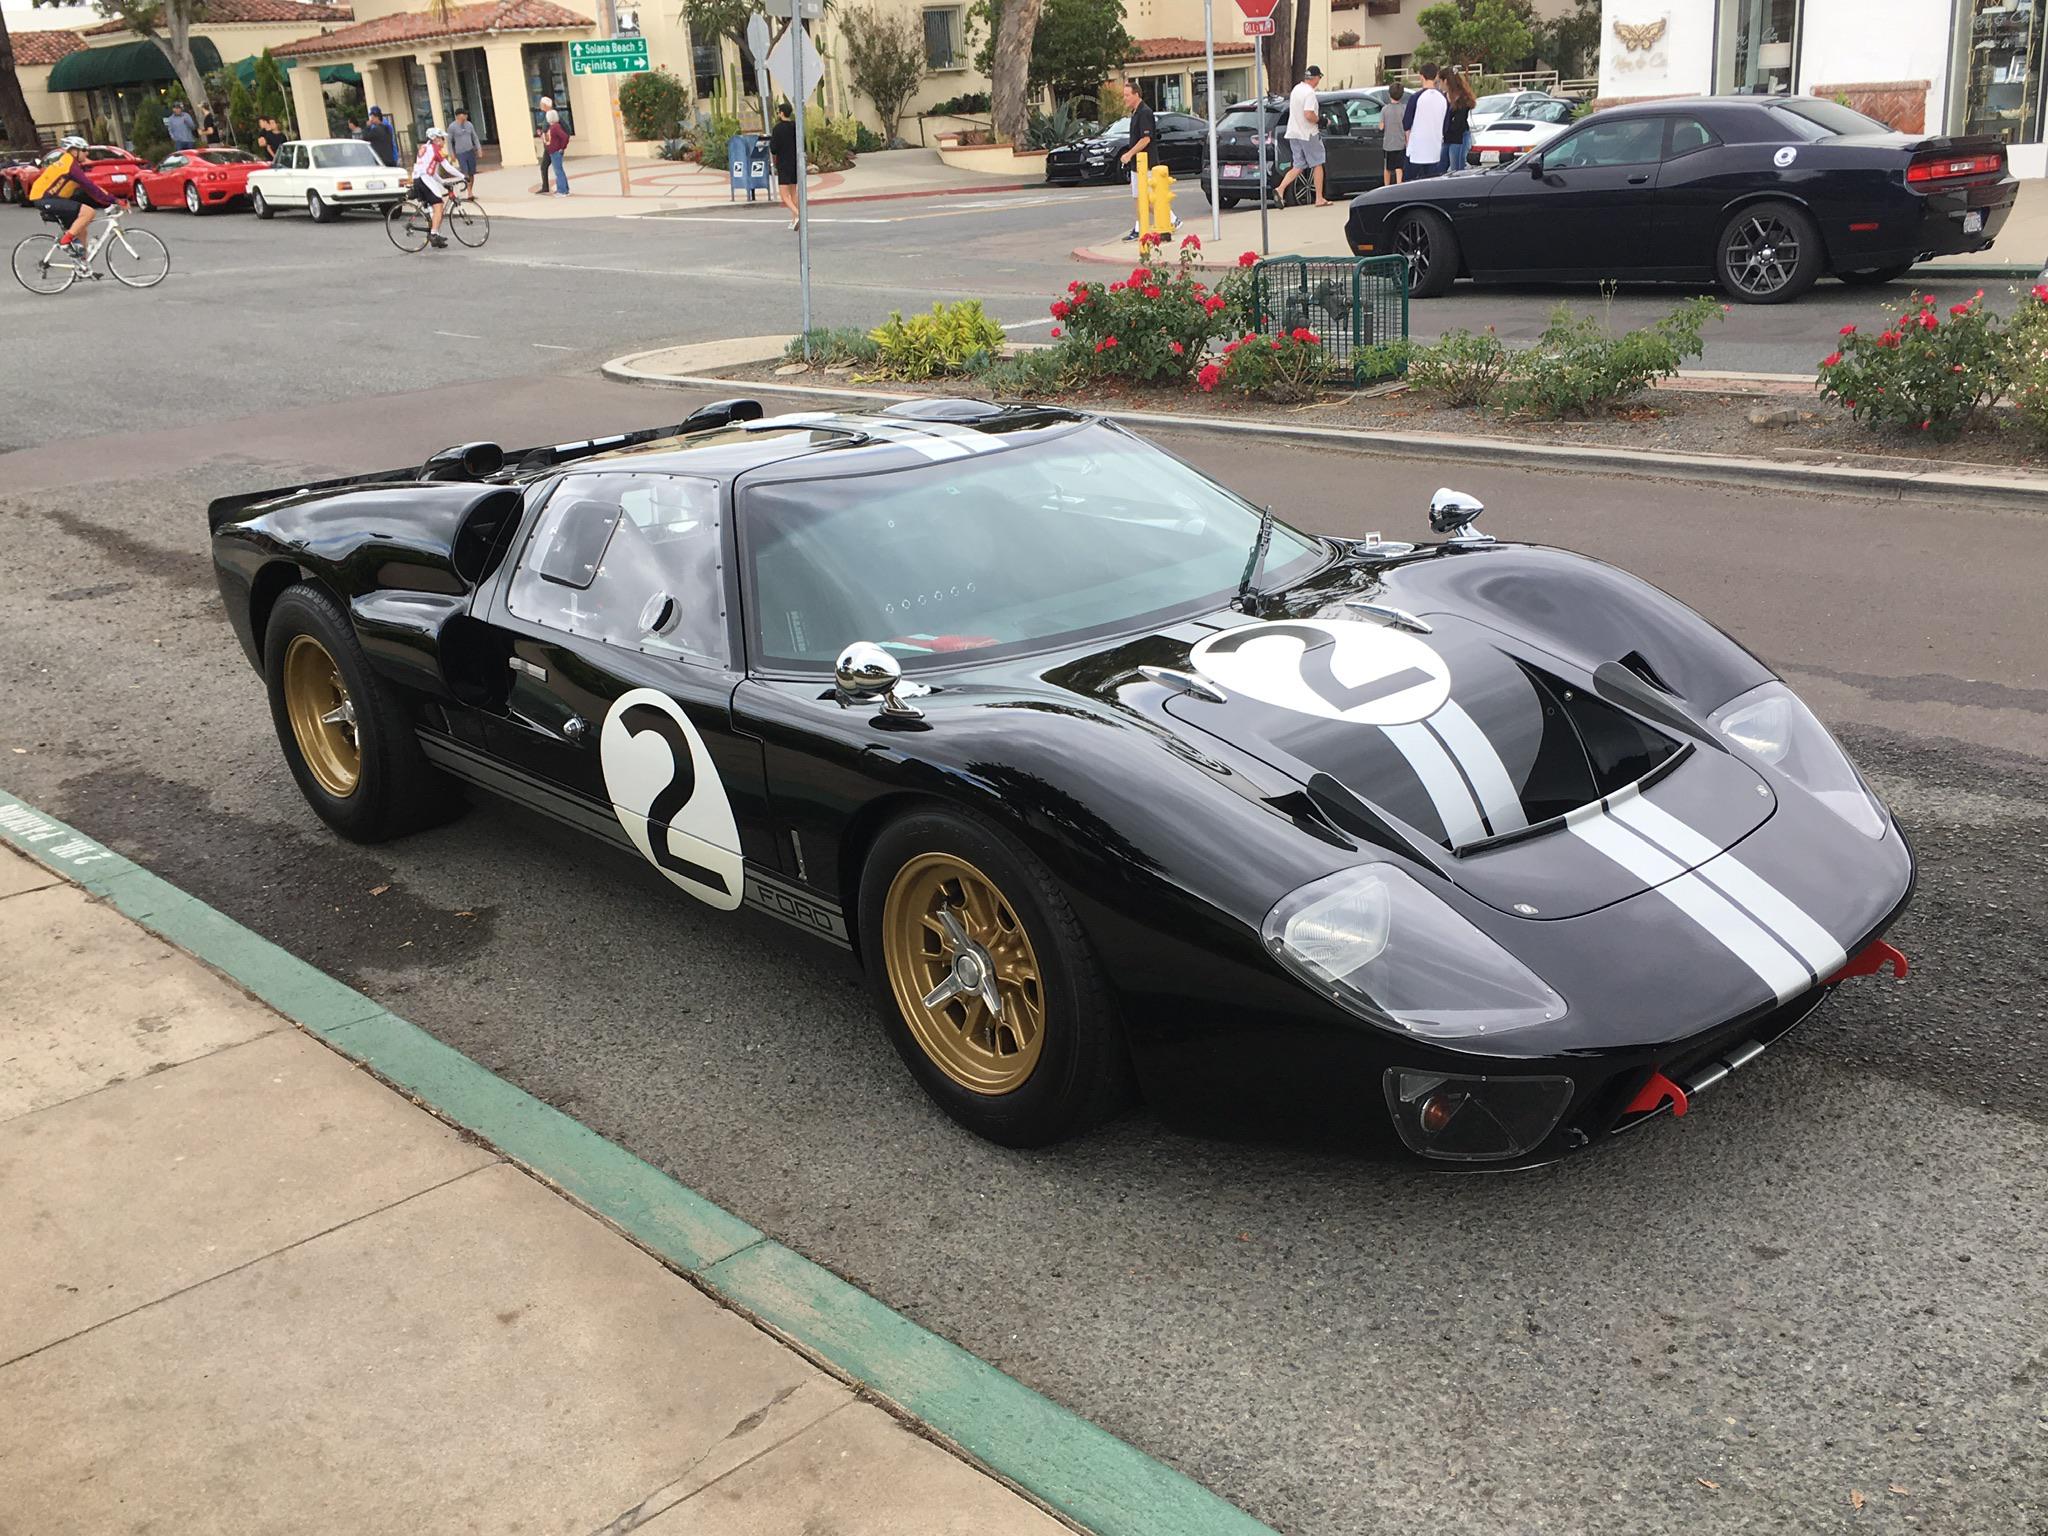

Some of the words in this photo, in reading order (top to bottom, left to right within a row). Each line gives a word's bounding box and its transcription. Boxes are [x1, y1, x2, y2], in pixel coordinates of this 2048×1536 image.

[574, 60, 618, 72] Encinitas
[623, 58, 629, 68] 7
[585, 43, 610, 55] Solana
[611, 42, 636, 53] Beach
[638, 41, 644, 51] 5
[1204, 624, 1437, 712] 2
[618, 702, 732, 897] 2
[757, 885, 834, 931] FORD
